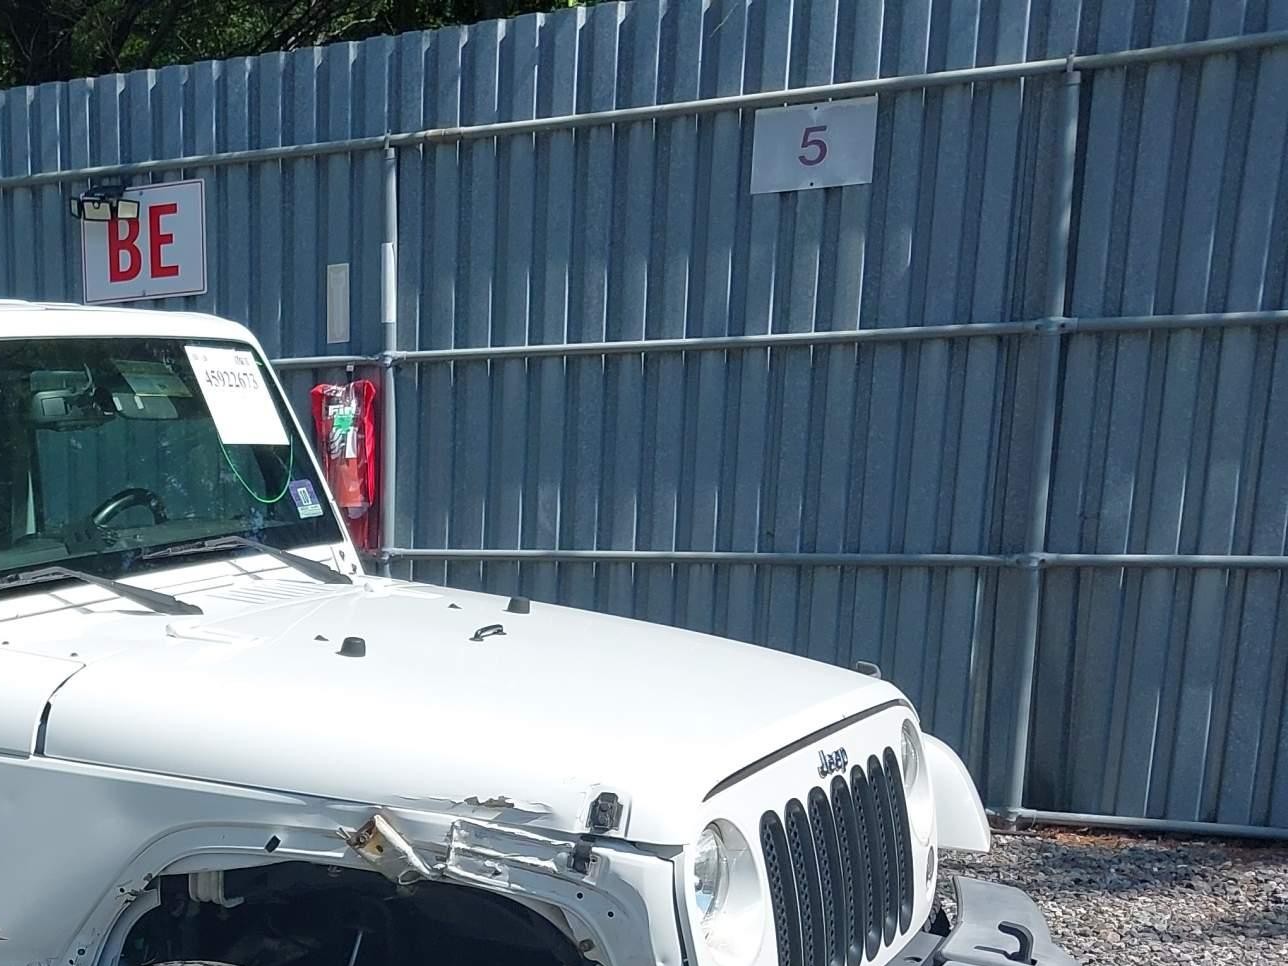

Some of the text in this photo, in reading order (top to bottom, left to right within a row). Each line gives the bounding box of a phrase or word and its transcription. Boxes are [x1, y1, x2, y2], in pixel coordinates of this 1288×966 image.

[798, 125, 828, 166] 5
[108, 203, 180, 283] BE
[204, 369, 260, 390] 45922673
[817, 747, 849, 779] Jeep
